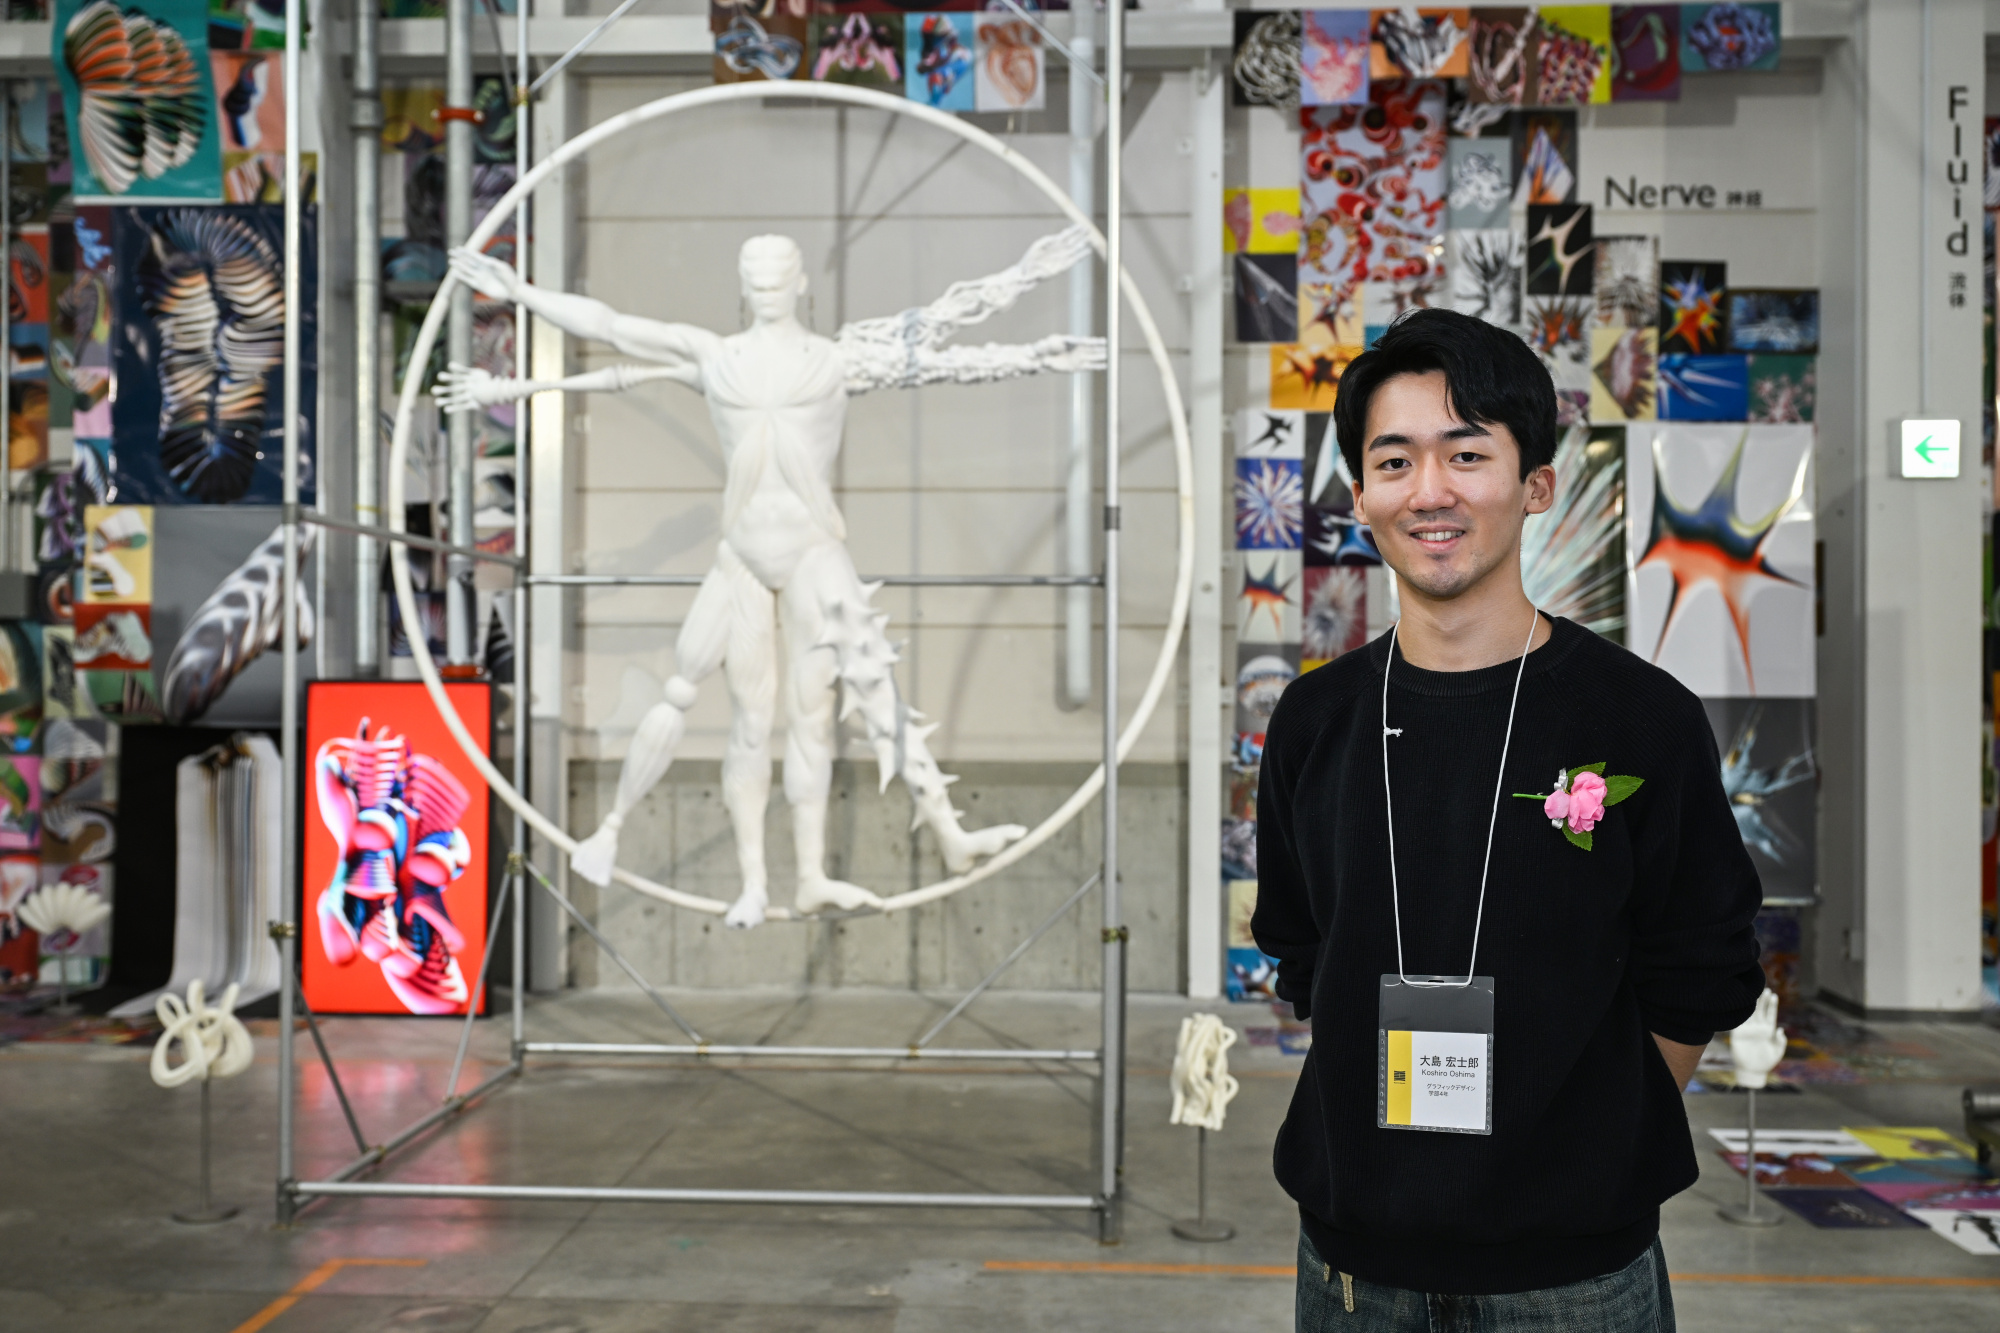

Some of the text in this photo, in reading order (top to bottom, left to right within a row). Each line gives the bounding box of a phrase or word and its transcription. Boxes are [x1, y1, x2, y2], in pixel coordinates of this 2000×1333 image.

[1946, 86, 1968, 256] Fluid
[1605, 175, 1716, 208] Nerve
[1420, 1055, 1479, 1069] 大島 宏士郎
[1421, 1069, 1476, 1078] Koshiro Oshima
[1427, 1083, 1476, 1091] グラフィックデザイン
